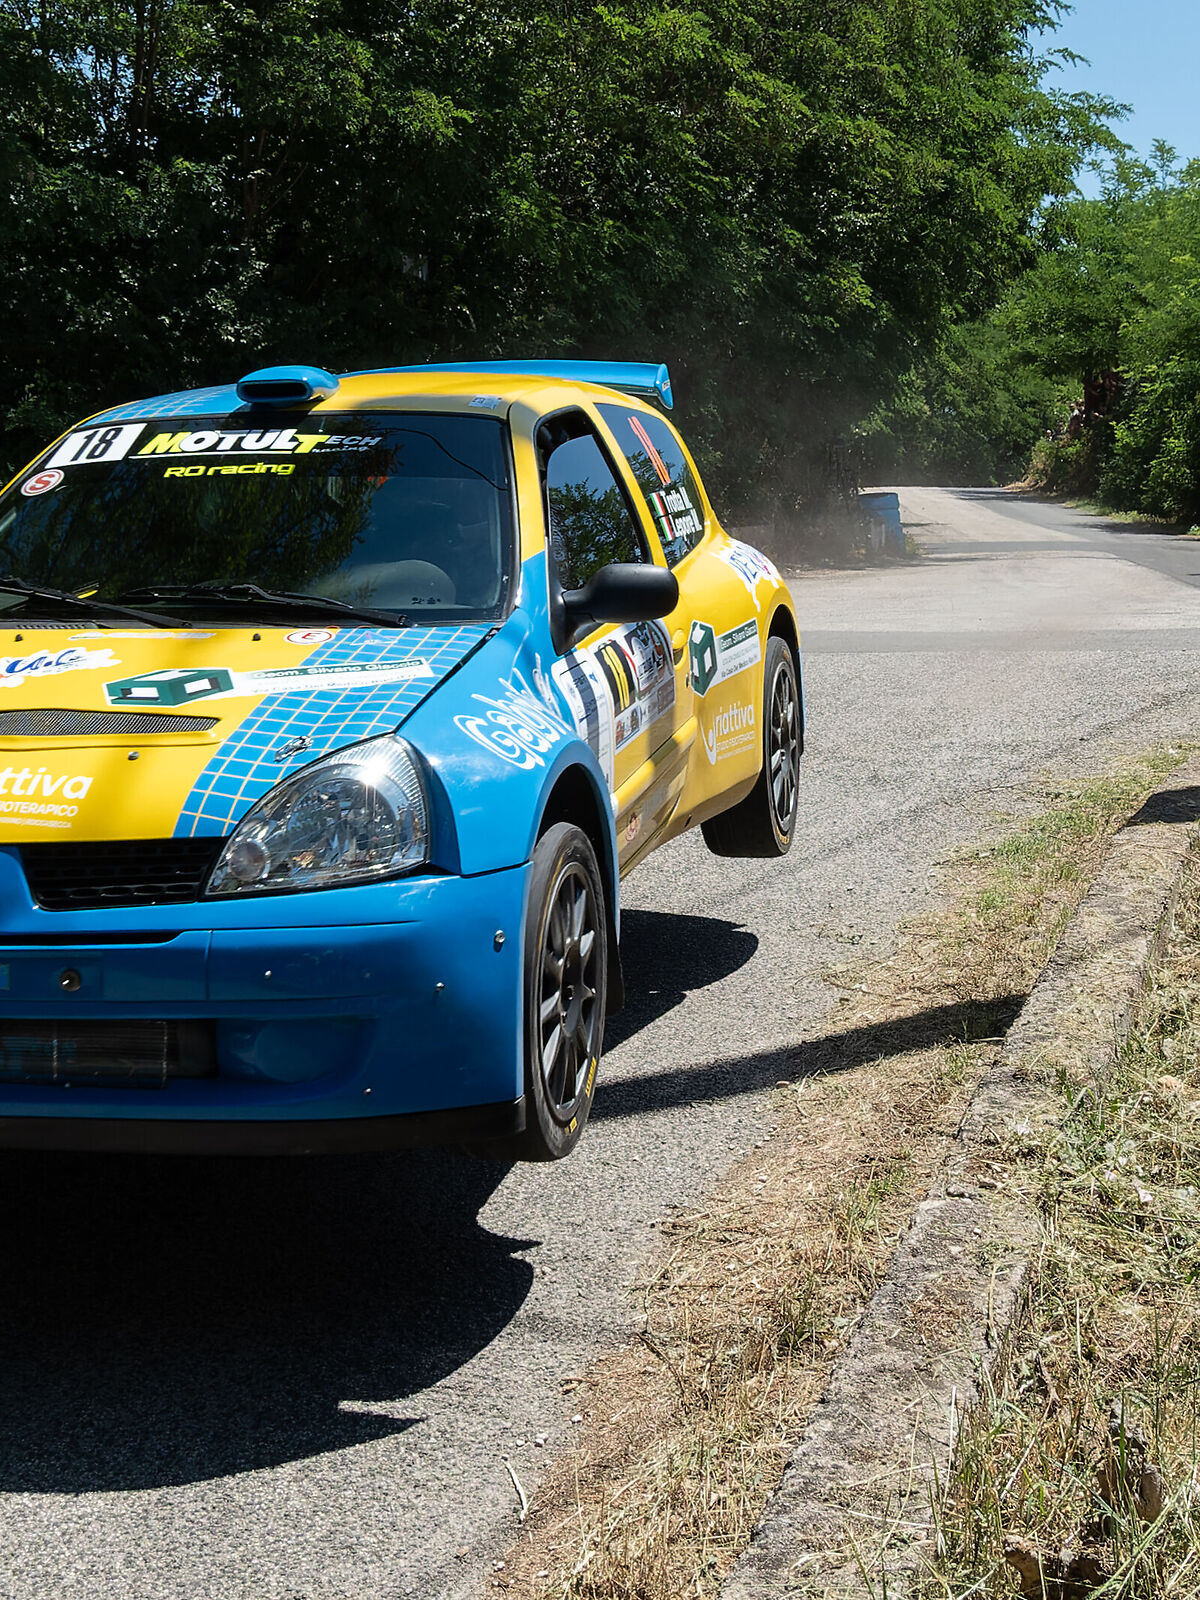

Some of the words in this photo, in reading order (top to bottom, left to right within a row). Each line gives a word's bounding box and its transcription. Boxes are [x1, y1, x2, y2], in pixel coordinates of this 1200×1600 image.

[70, 427, 124, 462] 18
[163, 465, 205, 478] RO
[206, 462, 296, 476] racing
[29, 474, 56, 491] S
[306, 664, 362, 676] Silvano
[715, 700, 755, 737] riattiva
